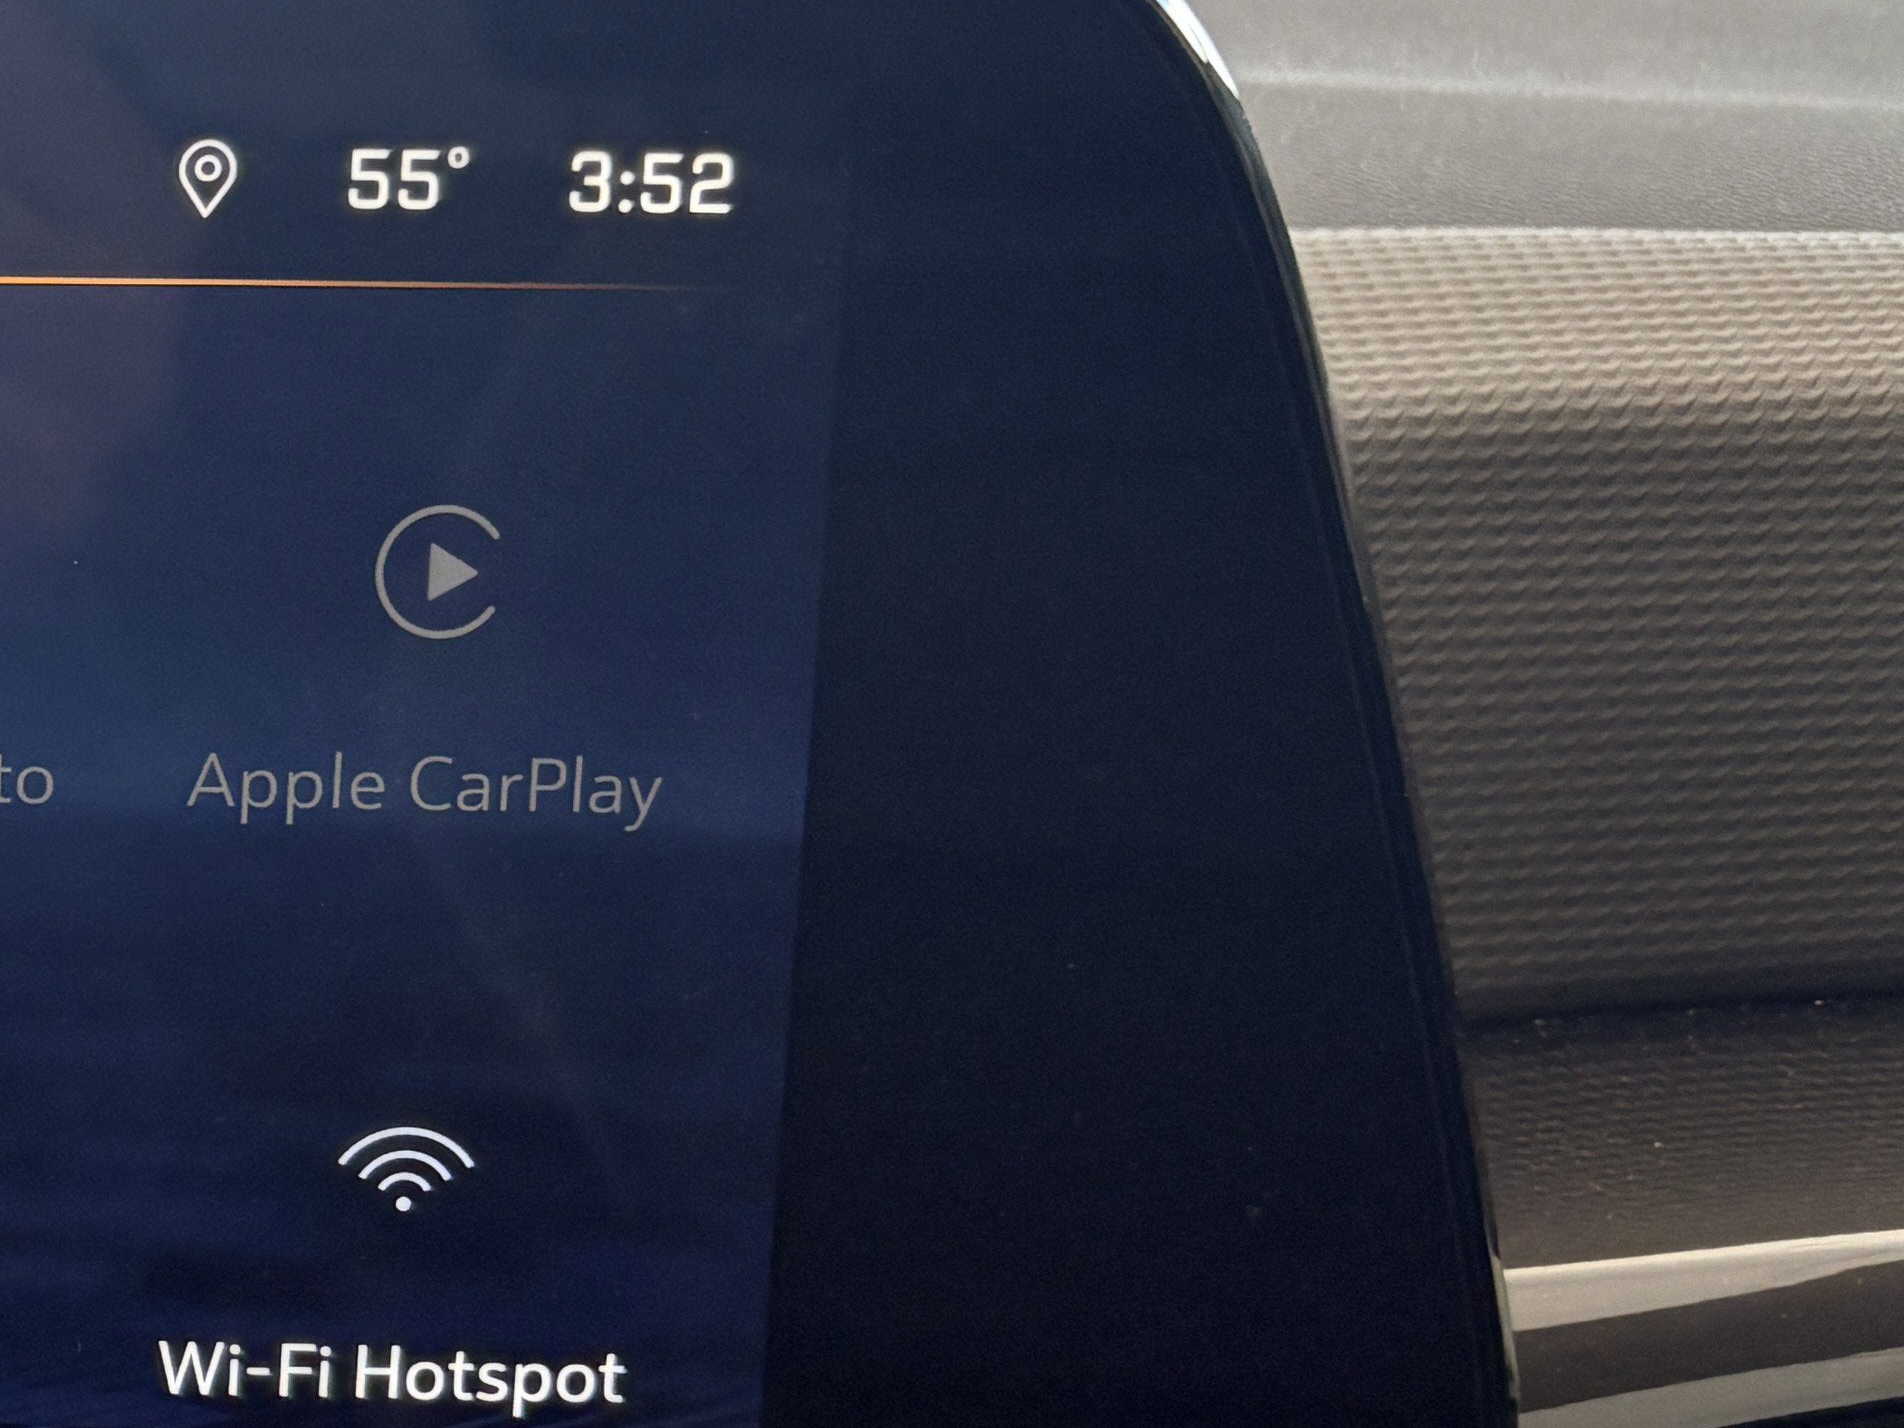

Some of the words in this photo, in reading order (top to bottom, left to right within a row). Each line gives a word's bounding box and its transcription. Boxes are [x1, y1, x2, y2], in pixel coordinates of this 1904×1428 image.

[347, 145, 471, 211] 55°
[568, 149, 735, 215] 3:52
[185, 750, 386, 826] Apple
[409, 754, 664, 833] CarPlay
[157, 1339, 333, 1399] Wi-Fi
[354, 1343, 628, 1419] Hotspot
